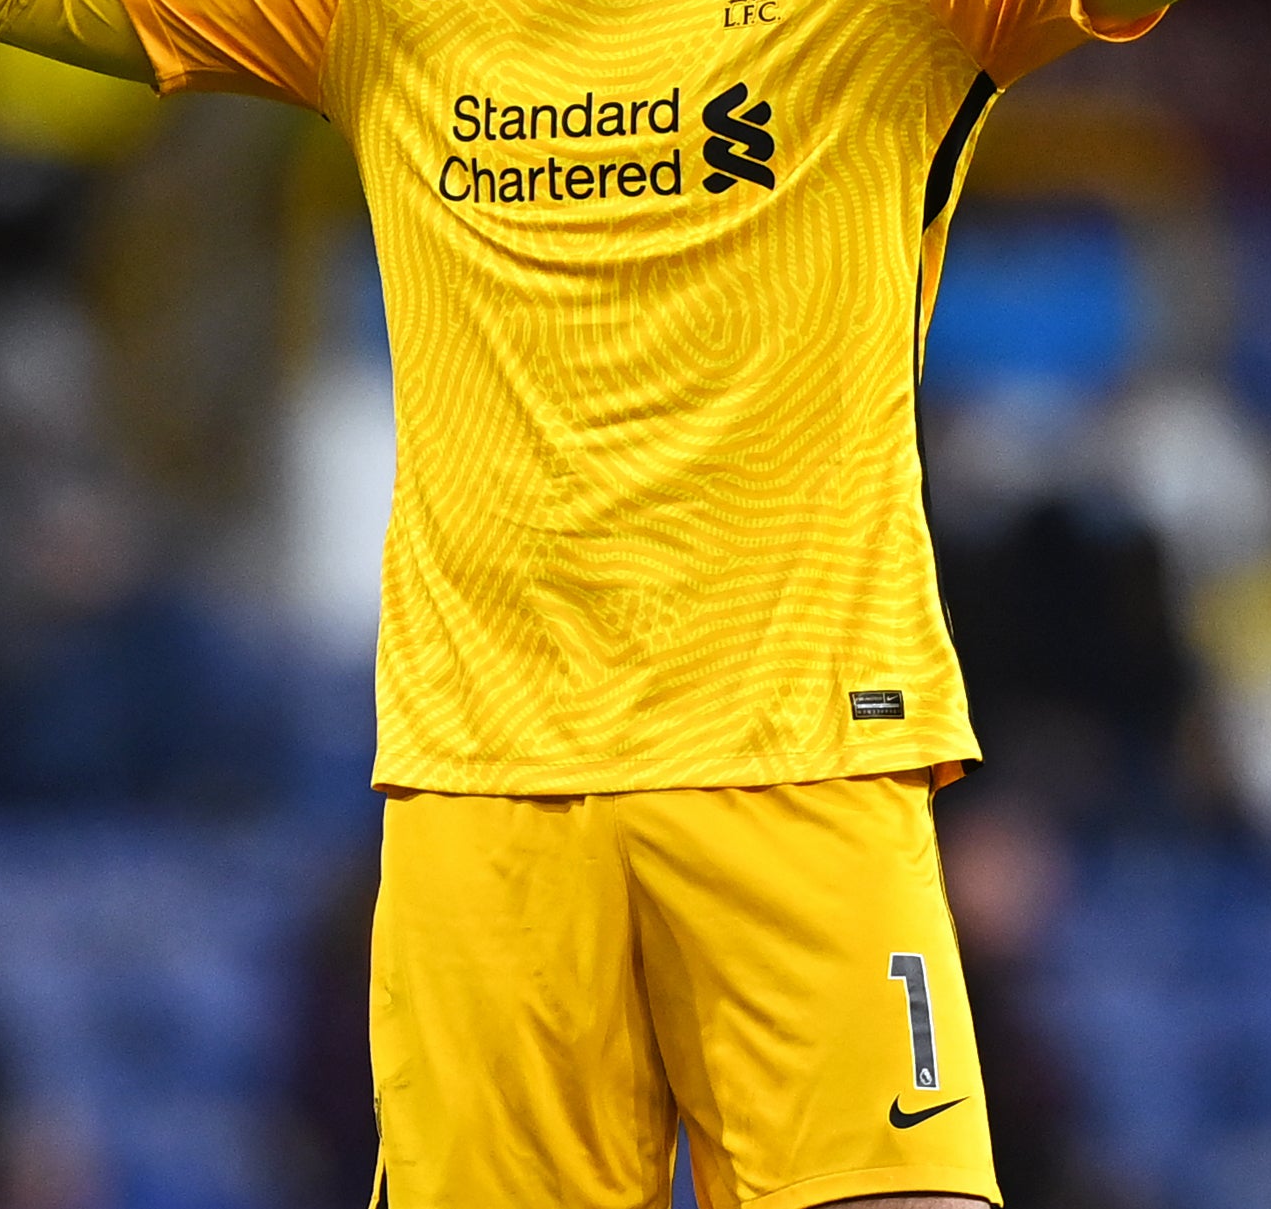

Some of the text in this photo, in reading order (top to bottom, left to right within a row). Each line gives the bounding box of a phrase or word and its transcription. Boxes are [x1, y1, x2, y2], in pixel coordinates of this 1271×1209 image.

[452, 87, 680, 142] Standard
[438, 148, 682, 204] Chartered
[887, 951, 940, 1091] 1
